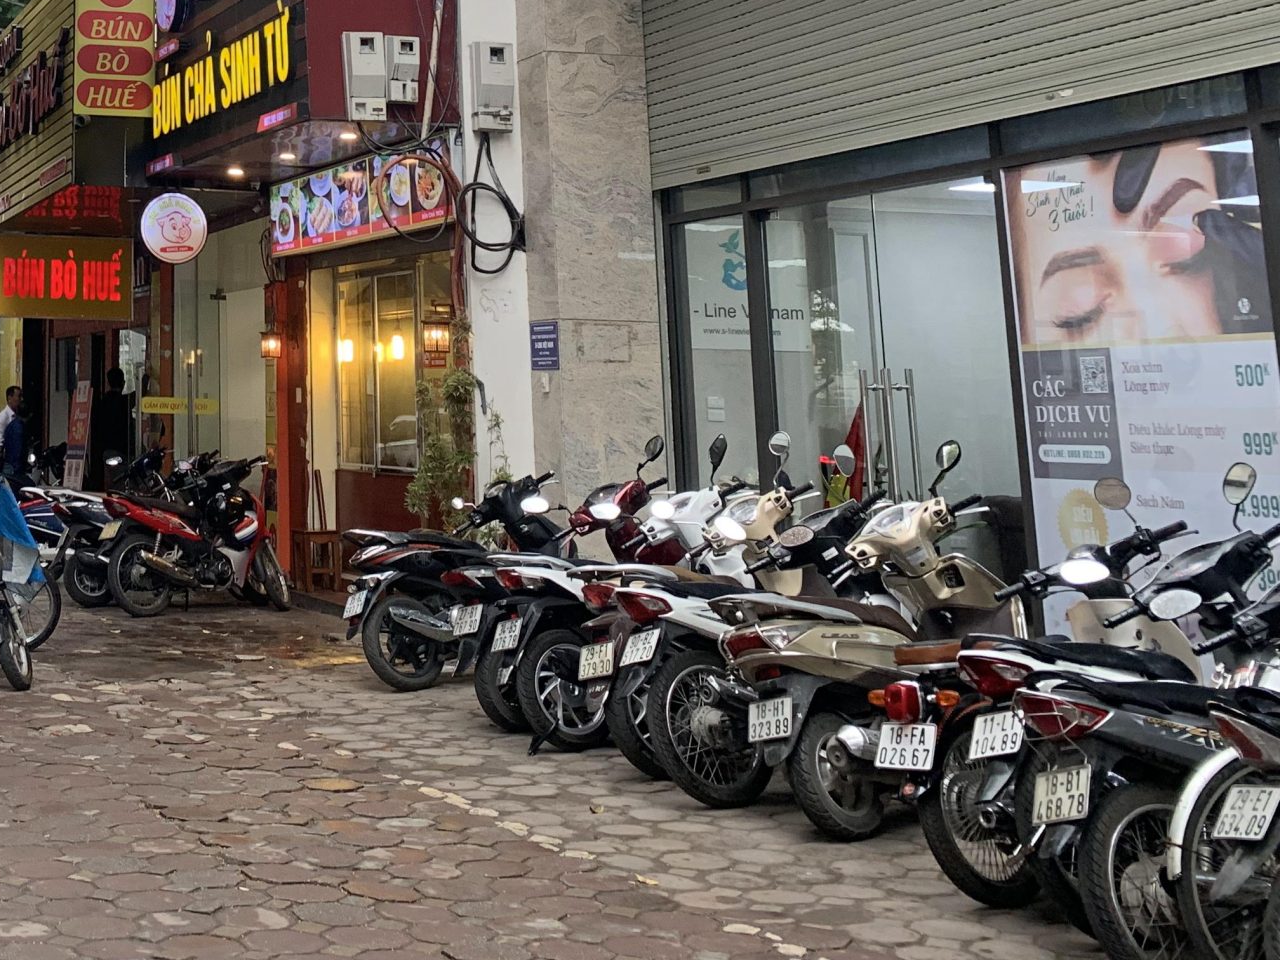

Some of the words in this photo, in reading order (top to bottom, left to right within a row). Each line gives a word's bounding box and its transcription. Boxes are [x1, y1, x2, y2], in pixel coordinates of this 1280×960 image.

[90, 16, 144, 41] BÚN
[95, 48, 130, 73] BÒ
[152, 63, 182, 140] BÚN
[184, 30, 216, 124] CHẢ
[220, 31, 261, 109] SINH
[263, 0, 290, 87] TỪ
[86, 81, 142, 108] HUẾ
[1048, 209, 1060, 232] 3
[3, 249, 45, 300] BÚN
[50, 249, 78, 300] BÒ
[83, 248, 123, 302] HUẾ
[704, 303, 737, 319] Line
[1032, 374, 1066, 398] CÁC
[1035, 405, 1081, 428] DỊCH
[1084, 405, 1111, 428] VỤ
[584, 643, 609, 662] 29-F1
[754, 700, 786, 720] 18-H1
[750, 718, 790, 742] 323.89
[889, 726, 927, 747] 18-FA
[981, 714, 1017, 735] 11-L1
[974, 732, 1019, 756] 104.89
[878, 746, 931, 768] 026.67
[1043, 770, 1082, 798] 18-B1
[1035, 792, 1085, 822] 468.78
[1229, 789, 1274, 812] 29-E1
[1216, 814, 1268, 838] 634.09
